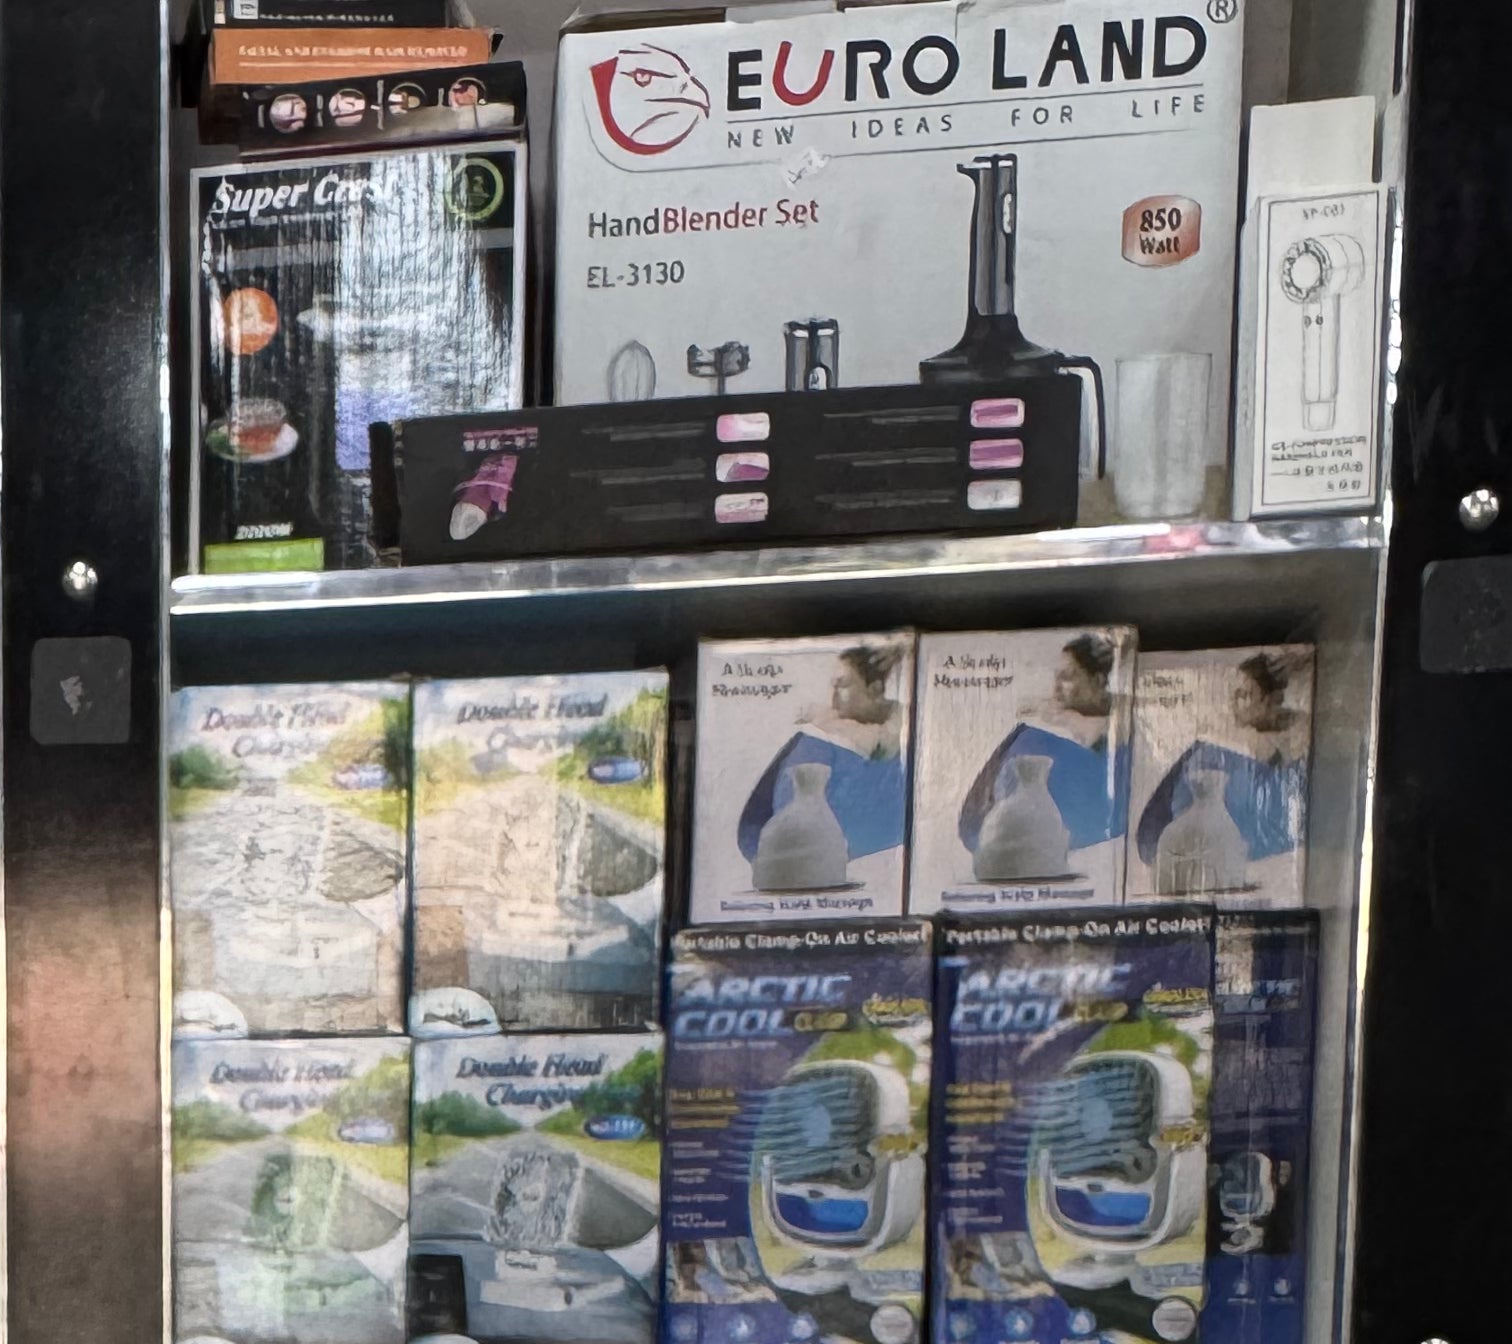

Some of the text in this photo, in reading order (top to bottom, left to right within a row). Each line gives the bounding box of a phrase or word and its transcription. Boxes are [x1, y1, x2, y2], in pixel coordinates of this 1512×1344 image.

[727, 16, 1208, 111] EURO LAND
[727, 94, 1206, 149] NEW IDEAS FOR LIFE
[212, 178, 310, 218] Super
[775, 198, 819, 227] Set
[1139, 207, 1183, 232] 850
[587, 260, 685, 289] EL-3130
[681, 972, 853, 1004] ARCTIC
[956, 962, 1133, 999] ARCTIC
[674, 1008, 794, 1037] COOL
[949, 1001, 1063, 1034] COOL
